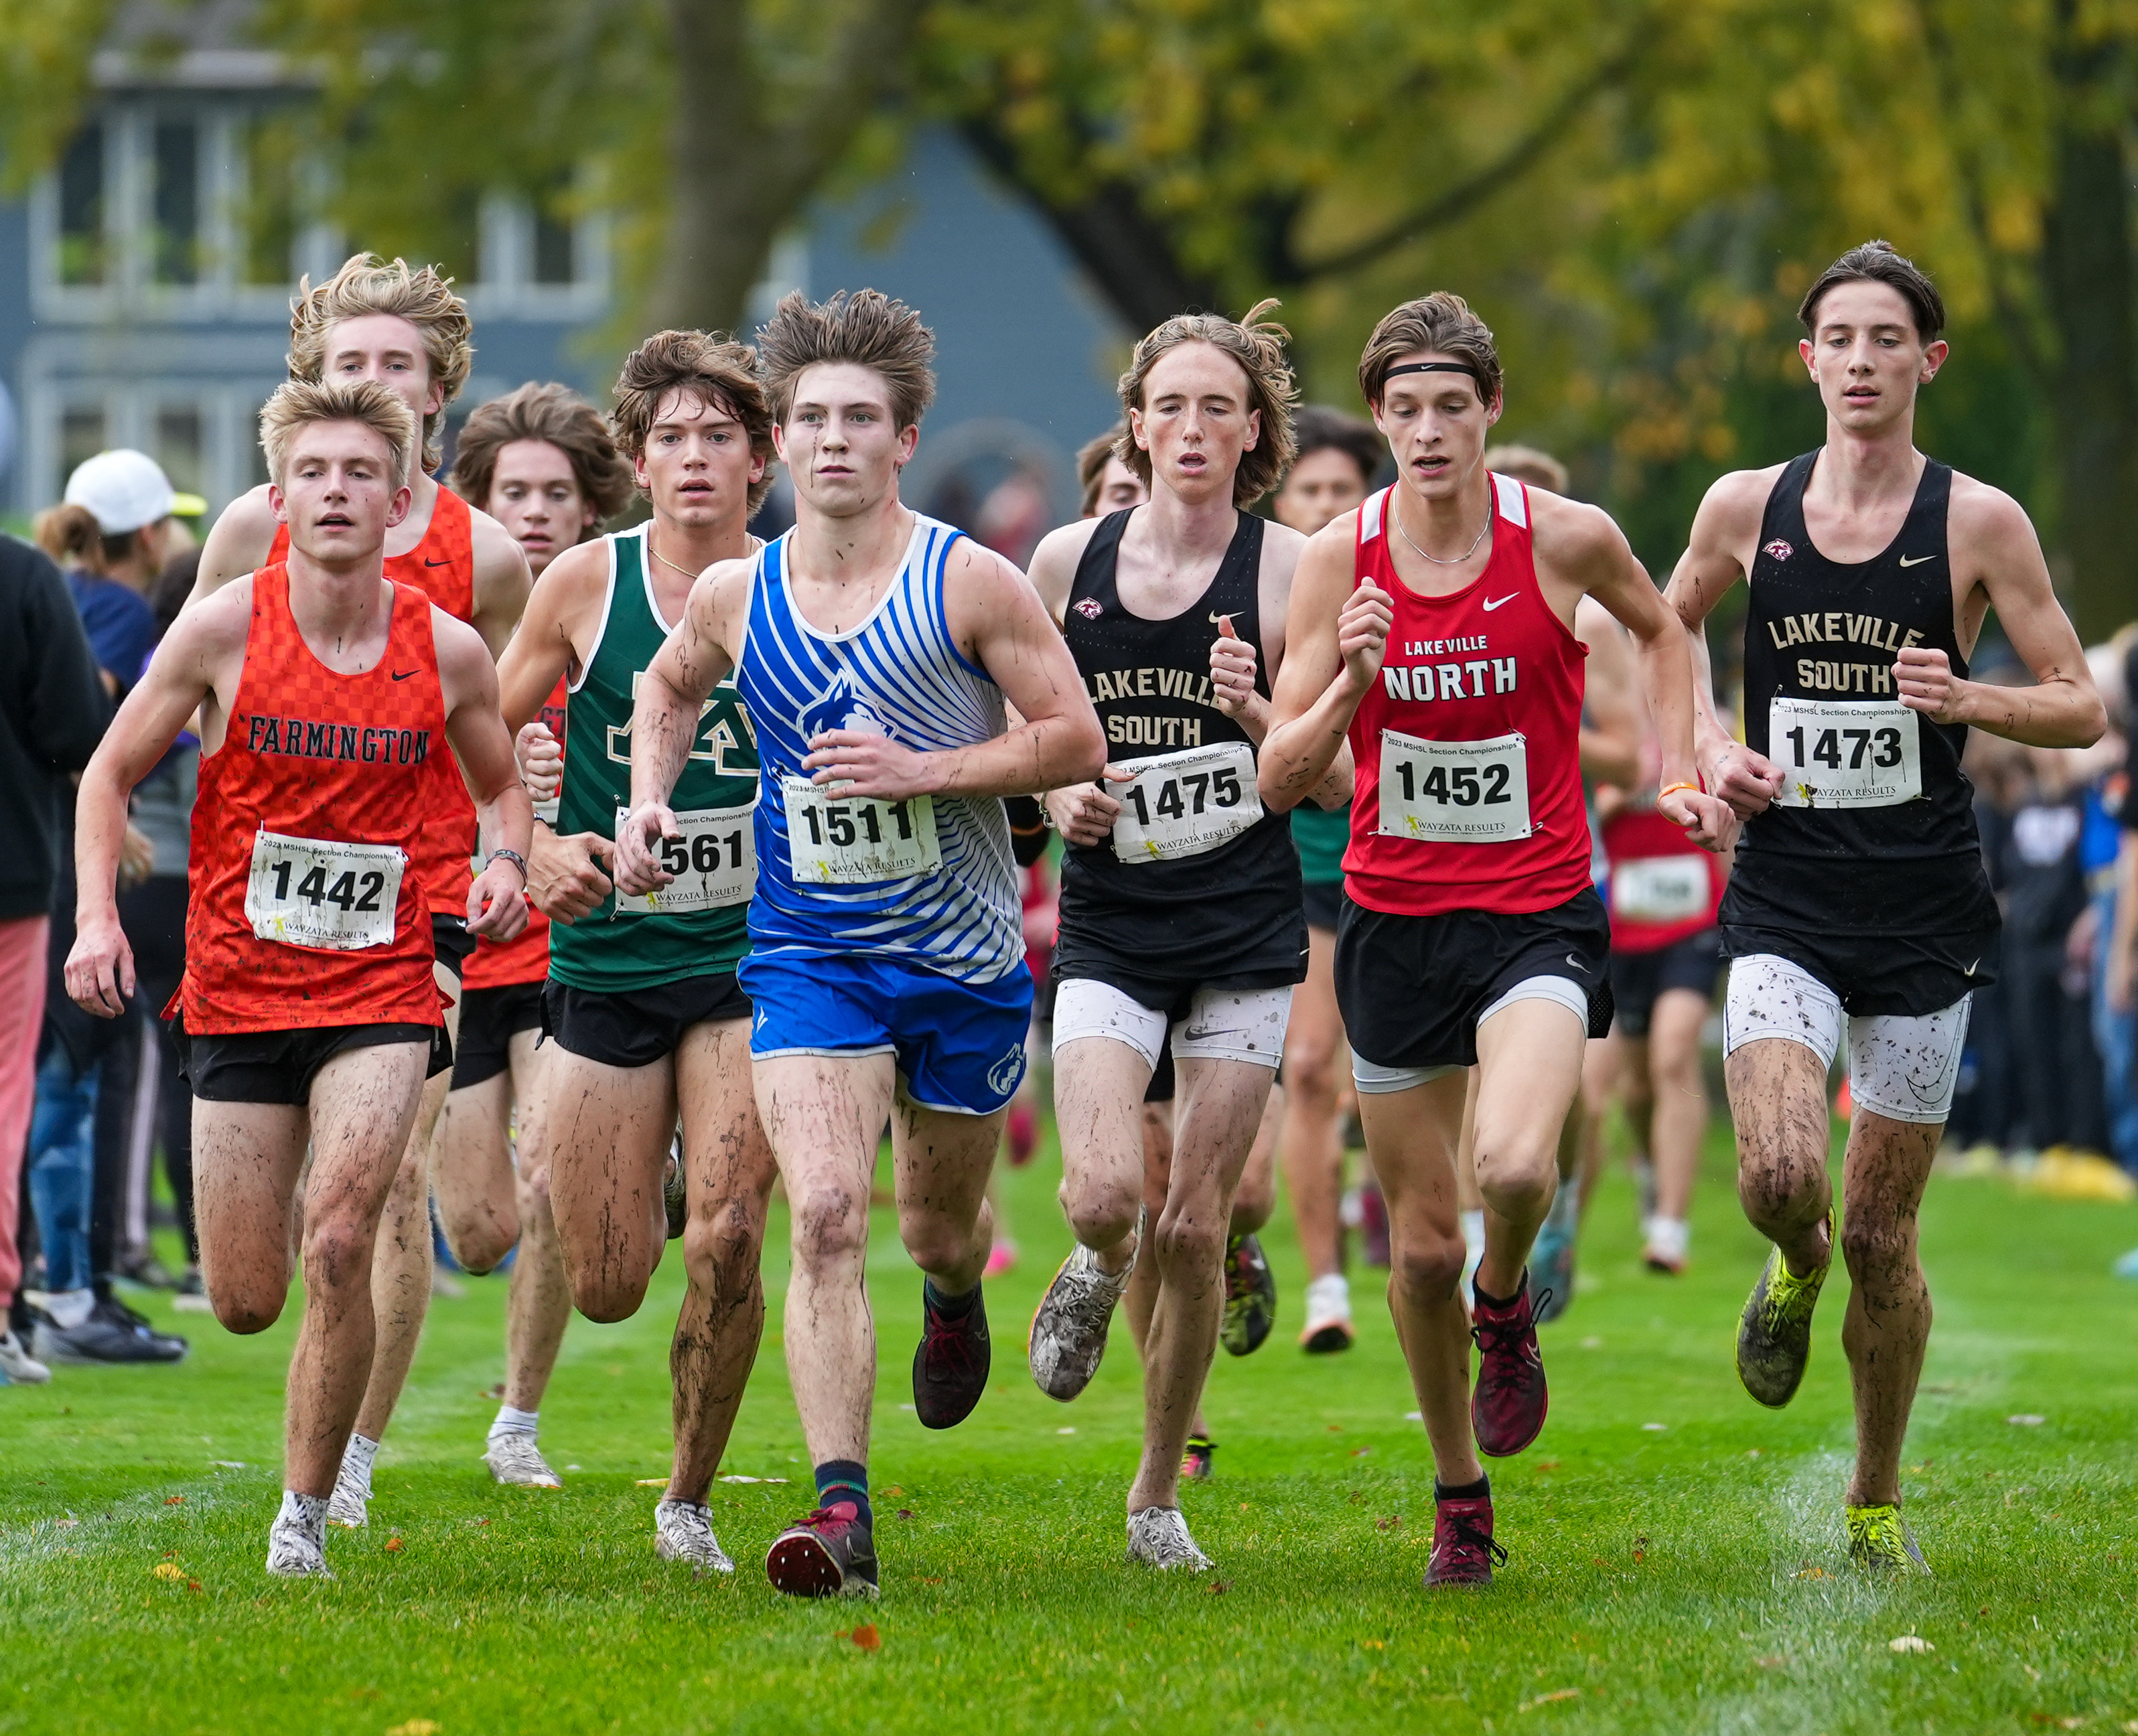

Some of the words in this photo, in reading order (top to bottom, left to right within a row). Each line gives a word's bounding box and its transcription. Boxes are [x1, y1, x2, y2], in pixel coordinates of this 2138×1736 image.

[1405, 635, 1488, 656] LAKEVILLE
[1767, 612, 1925, 652] LAKEVILLE
[1382, 656, 1516, 701] NORTH
[1797, 658, 1890, 693] SOUTH
[1793, 707, 1819, 715] MSHSL
[247, 715, 431, 765] FARMINGTON
[1107, 715, 1201, 746] SOUTH
[1157, 760, 1186, 769] Section
[1188, 747, 1243, 764] Championships
[1388, 738, 1402, 747] 2023
[1404, 742, 1427, 753] MSHSL
[1459, 742, 1517, 755] Championships
[1786, 726, 1902, 770] 1473
[1126, 767, 1242, 825] 1475
[1396, 761, 1511, 806] 1452
[1809, 788, 1853, 797] AYZATA
[1856, 786, 1896, 796] RESULTS
[802, 802, 912, 847] 1511
[1157, 835, 1201, 851] WAYZATA
[1203, 825, 1241, 841] RESULTS
[1418, 821, 1462, 831] WAYZATA
[1465, 822, 1506, 831] RESULTS
[283, 843, 312, 853] MSHSL
[313, 847, 341, 857] Section
[344, 851, 397, 861] Championships
[271, 860, 384, 912] 1442
[656, 891, 700, 901] WAYZATA
[703, 884, 741, 898] RESULTS
[285, 922, 328, 937] WAYZATA
[332, 930, 369, 939] RESULTS
